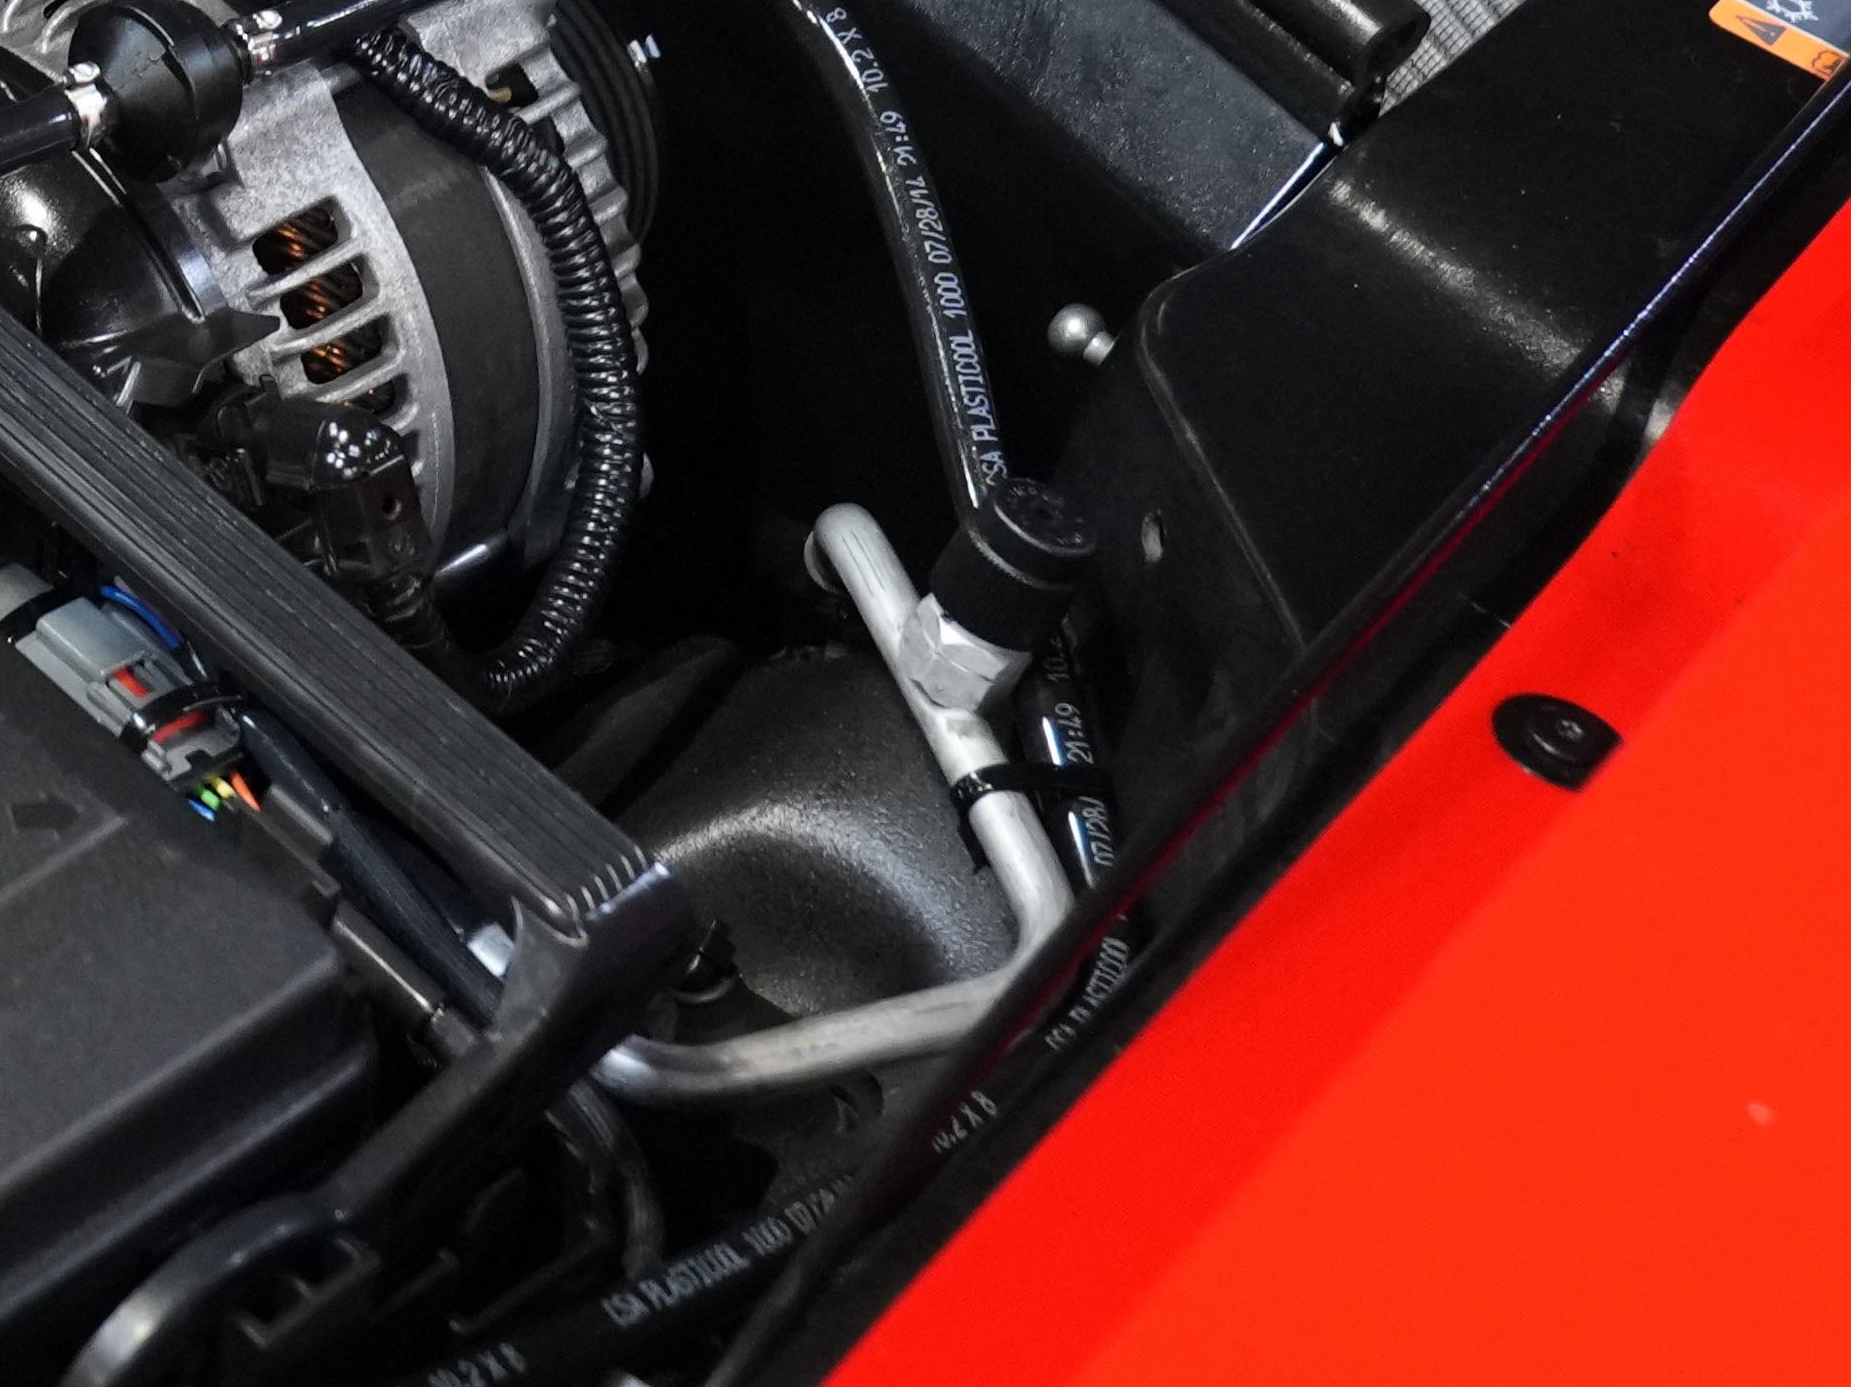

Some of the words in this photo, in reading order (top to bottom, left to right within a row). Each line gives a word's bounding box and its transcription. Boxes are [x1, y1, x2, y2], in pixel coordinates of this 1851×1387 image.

[850, 46, 889, 94] 10.2
[878, 109, 918, 167] 21:49
[903, 174, 955, 265] 07/28/14
[932, 271, 969, 320] 1000
[947, 327, 1000, 455] PLASTICOOL
